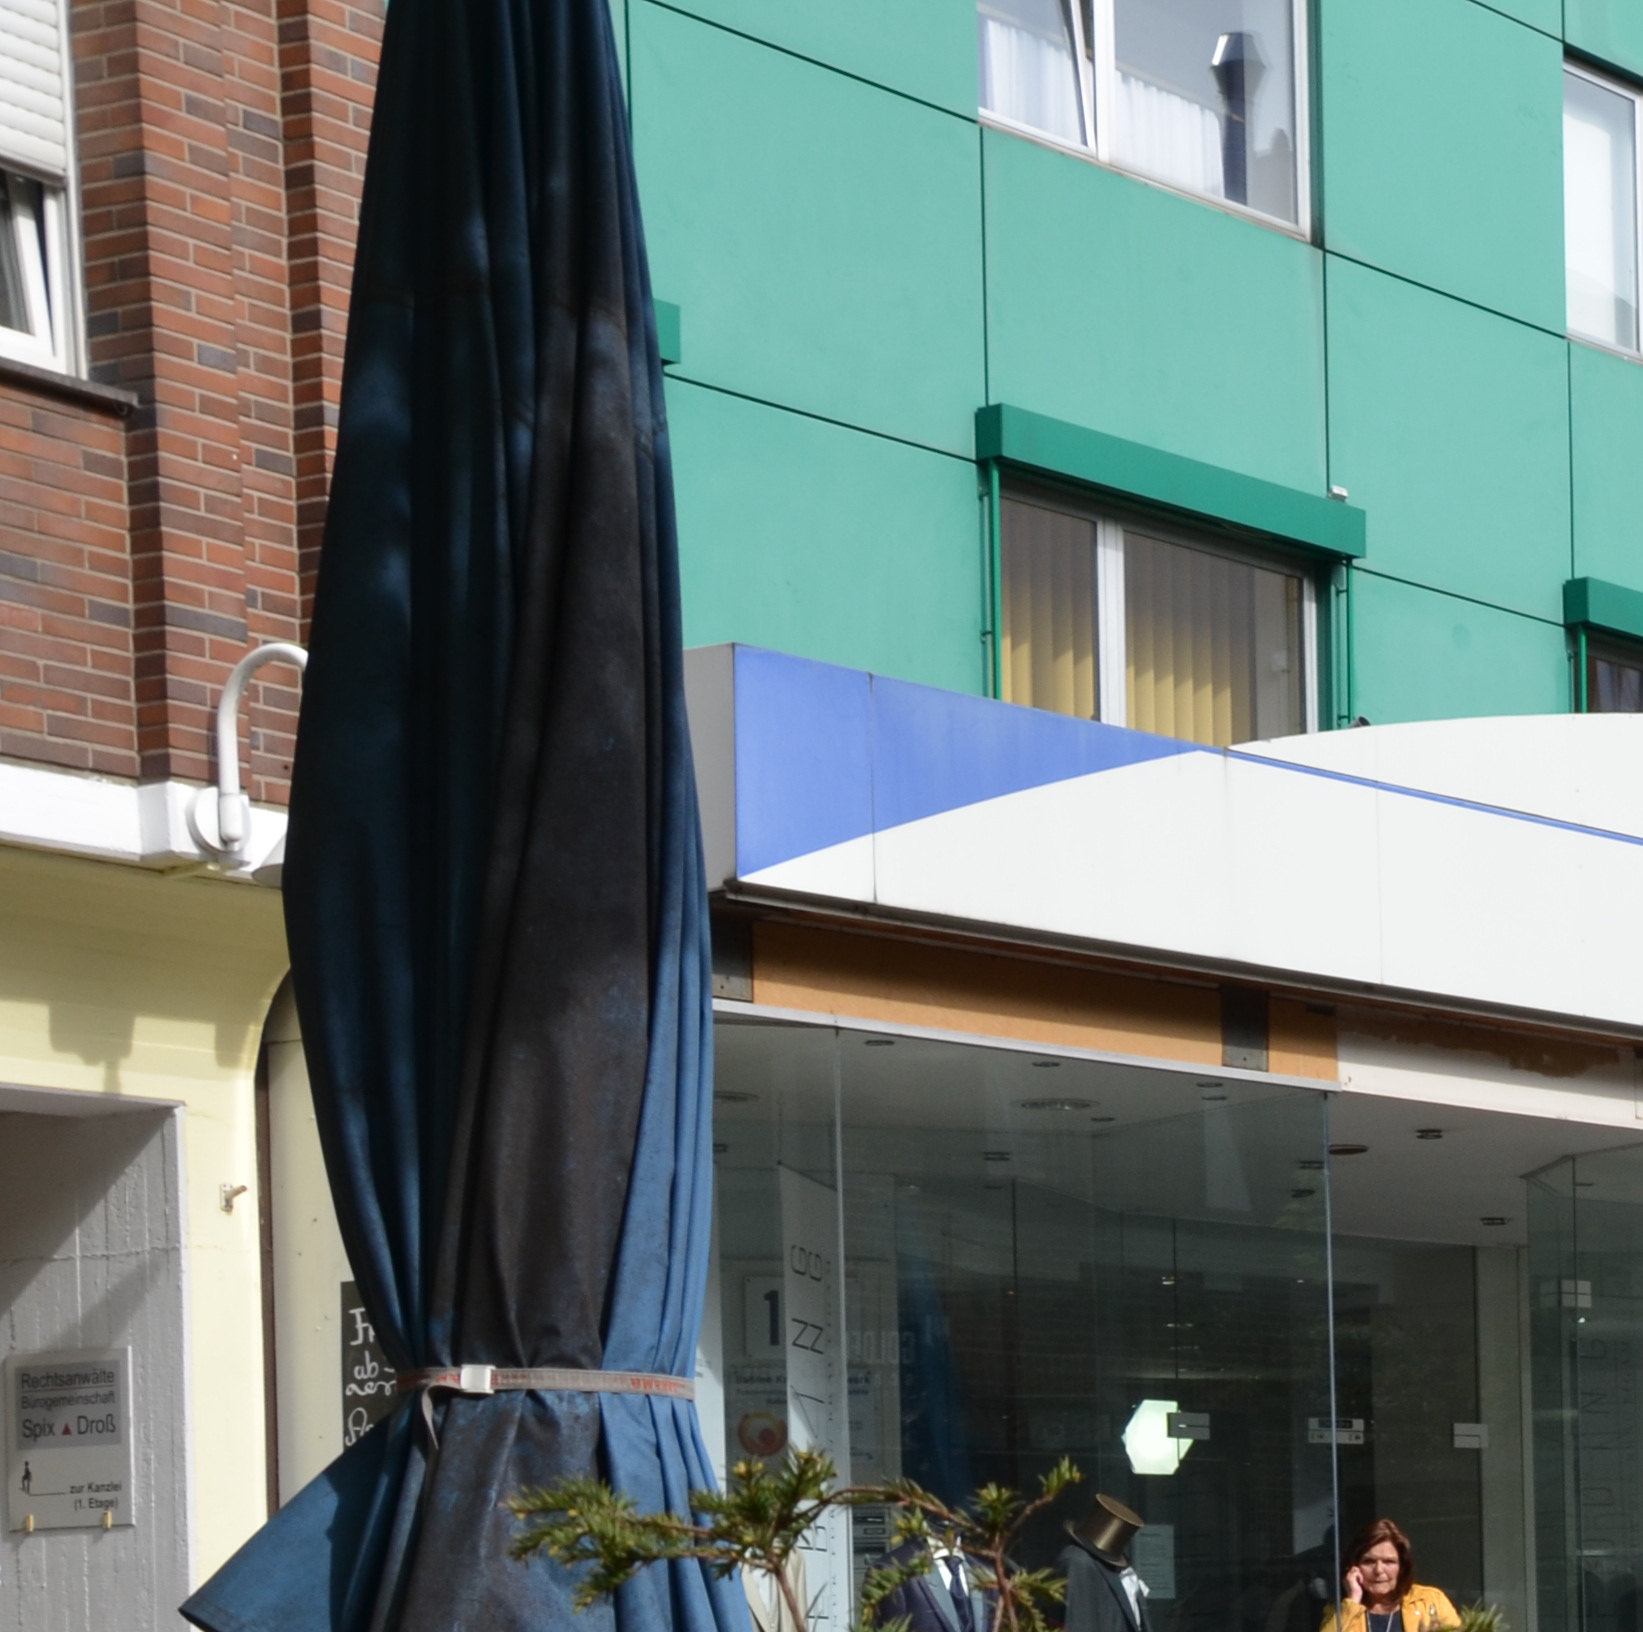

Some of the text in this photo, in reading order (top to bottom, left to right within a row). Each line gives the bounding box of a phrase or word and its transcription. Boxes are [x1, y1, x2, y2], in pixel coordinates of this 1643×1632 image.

[20, 1368, 115, 1390] Rechtsanwälte
[20, 1390, 116, 1411] Bürogemeinschaft
[22, 1413, 117, 1442] Spix Droß
[69, 1481, 122, 1495] zur Kanzlei
[74, 1497, 119, 1512] (1. Etage)
